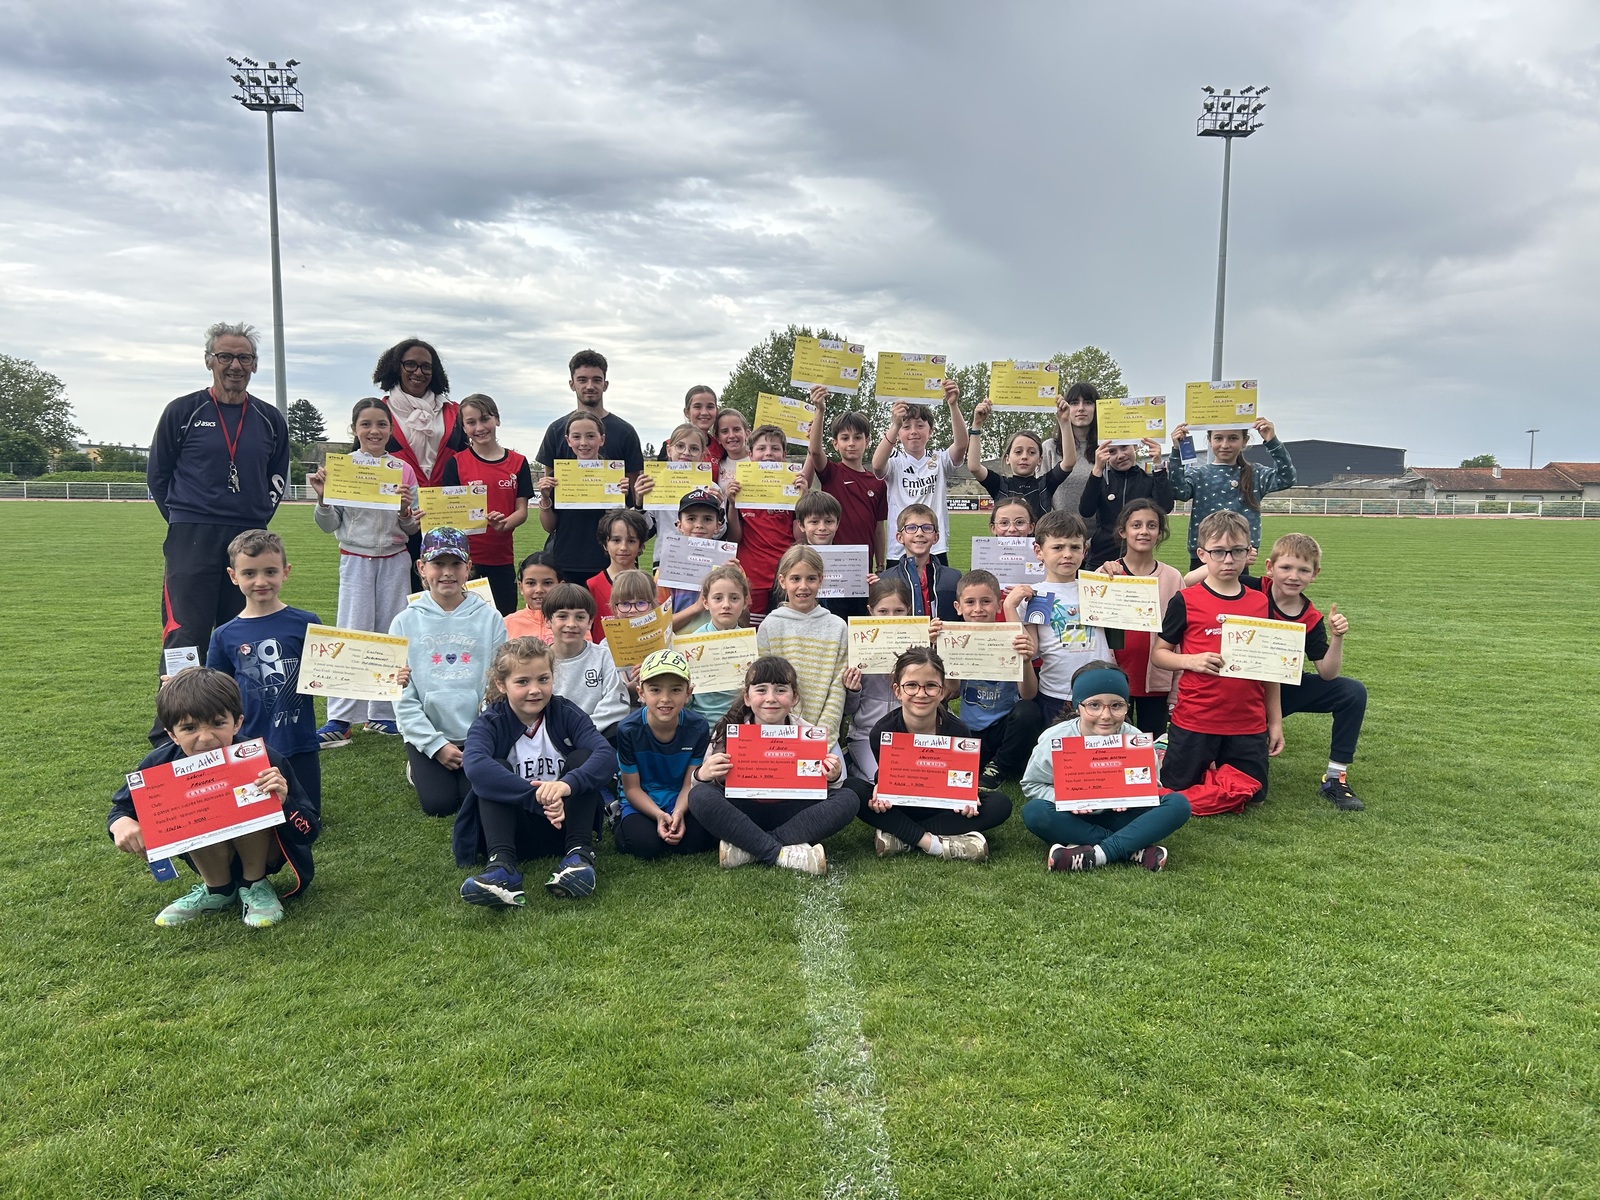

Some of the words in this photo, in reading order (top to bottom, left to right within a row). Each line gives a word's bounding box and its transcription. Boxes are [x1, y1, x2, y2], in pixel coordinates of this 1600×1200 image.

[194, 419, 217, 428] asics
[688, 491, 704, 499] cal
[976, 690, 1001, 701] SPIRIT
